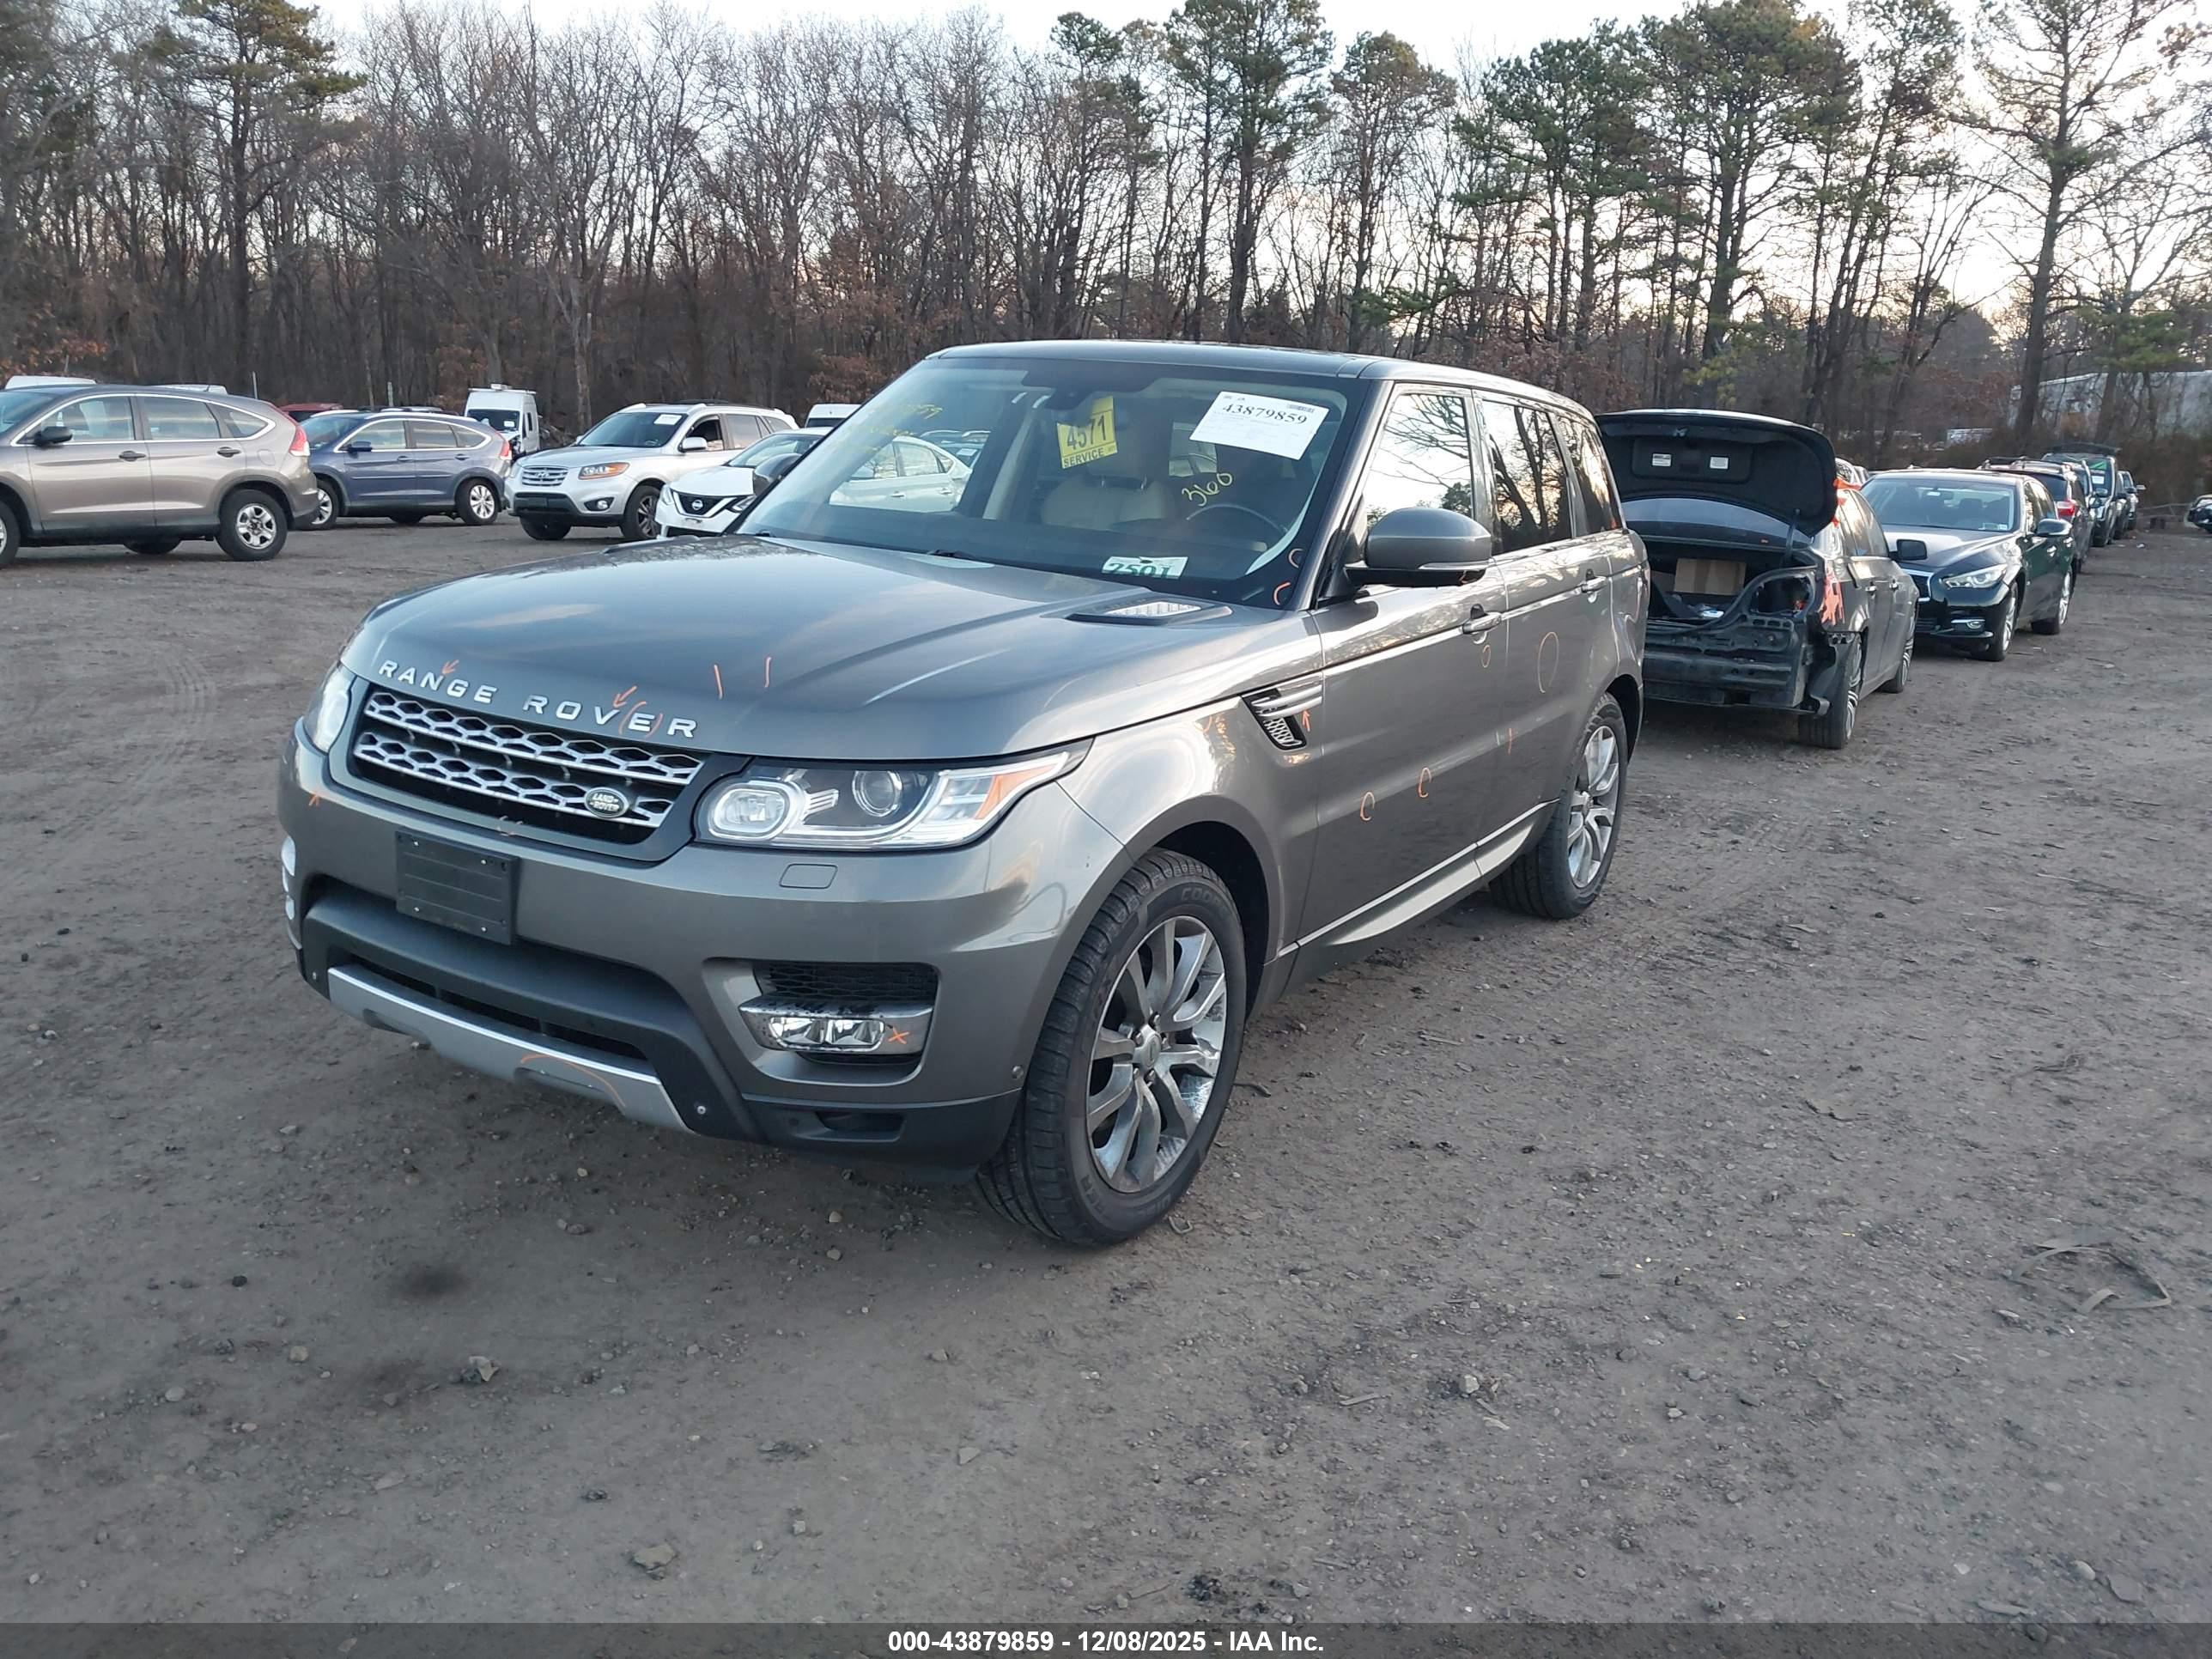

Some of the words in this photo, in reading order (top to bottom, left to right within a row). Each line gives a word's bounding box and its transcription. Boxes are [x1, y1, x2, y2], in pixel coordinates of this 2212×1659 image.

[1223, 404, 1308, 426] 43879859
[1066, 414, 1107, 451] 4571
[1063, 447, 1104, 468] SERVICE
[1181, 472, 1233, 507] 360
[377, 659, 498, 706] RANGE
[522, 694, 699, 739] ROVER
[591, 793, 615, 804] LAND
[592, 800, 621, 812] ROVER
